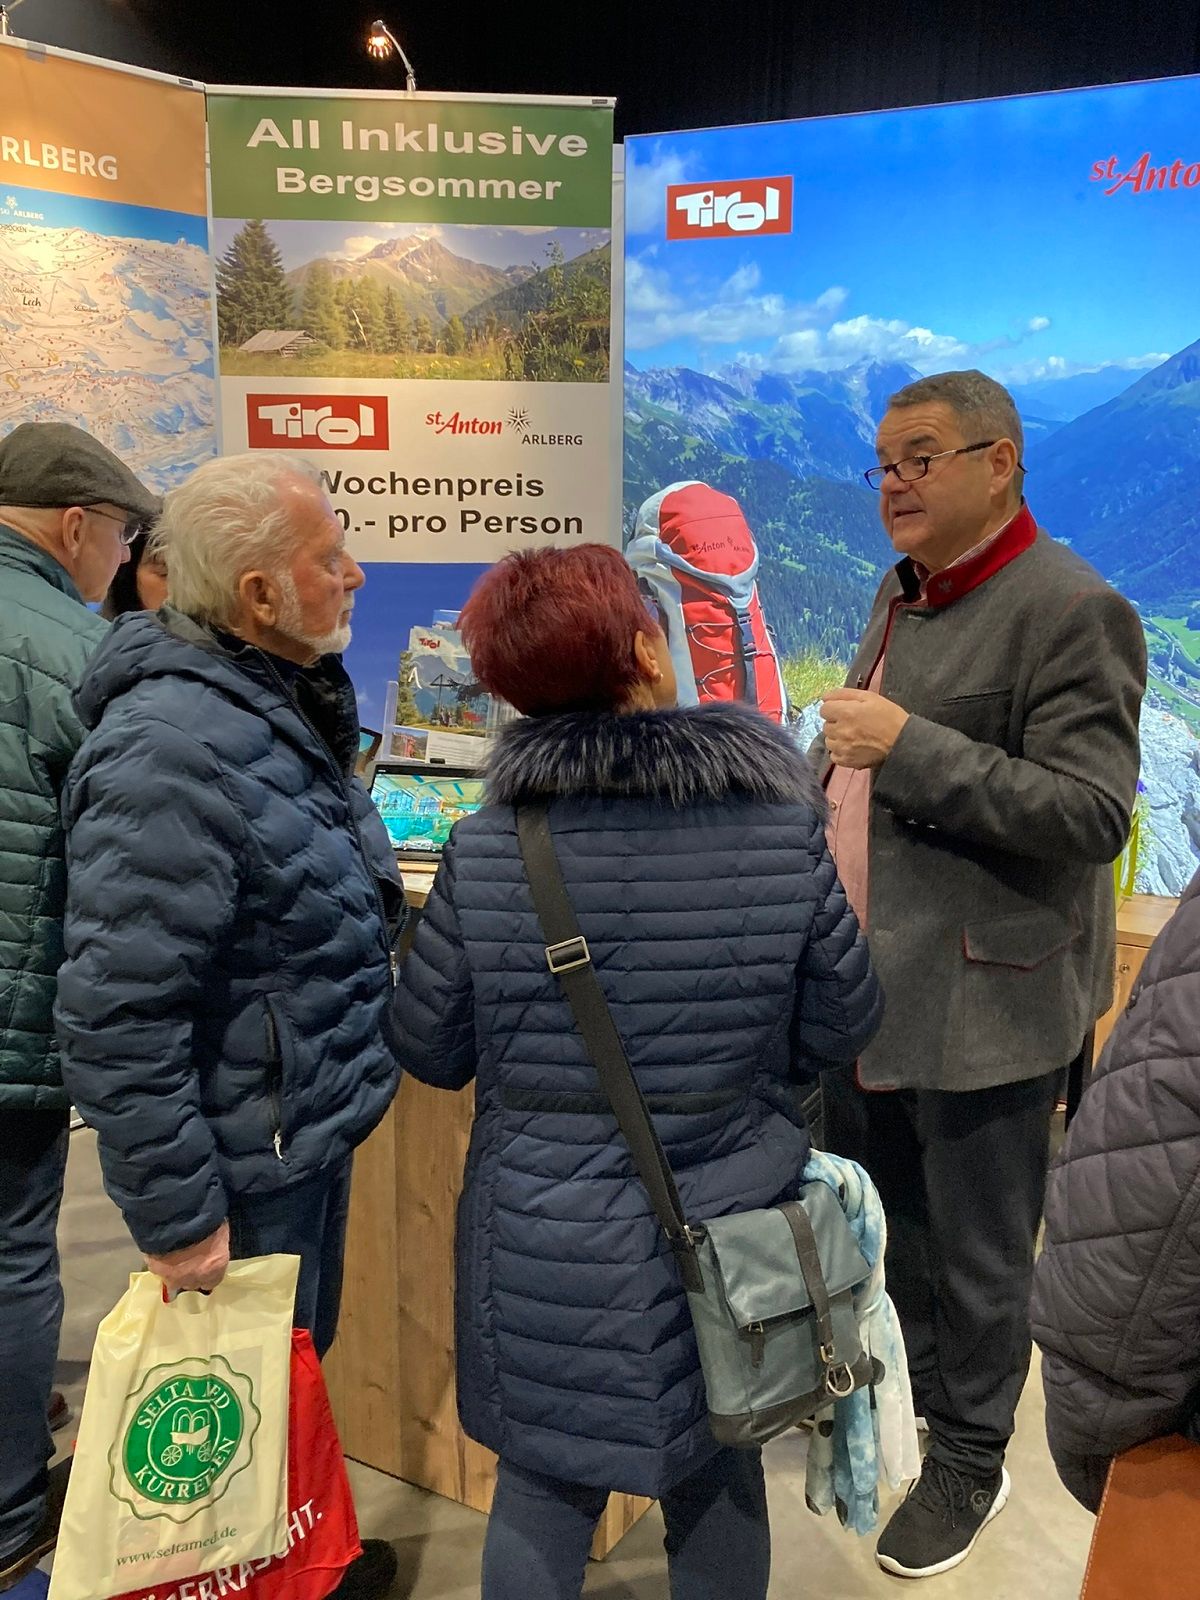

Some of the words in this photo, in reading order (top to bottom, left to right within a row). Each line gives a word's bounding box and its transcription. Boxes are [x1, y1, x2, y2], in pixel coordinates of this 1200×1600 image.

[246, 118, 320, 150] All
[342, 121, 588, 157] Inklusive
[276, 167, 562, 202] Bergsommer
[676, 186, 780, 231] Tirol
[23, 296, 41, 306] Lech
[258, 402, 375, 445] Tirol
[521, 434, 583, 446] ARLBERG
[388, 513, 447, 538] pro
[460, 509, 583, 534] Person
[137, 1381, 194, 1429] SELTA
[134, 1437, 236, 1498] KURREIEN
[116, 1525, 237, 1567] www.seltamed.de
